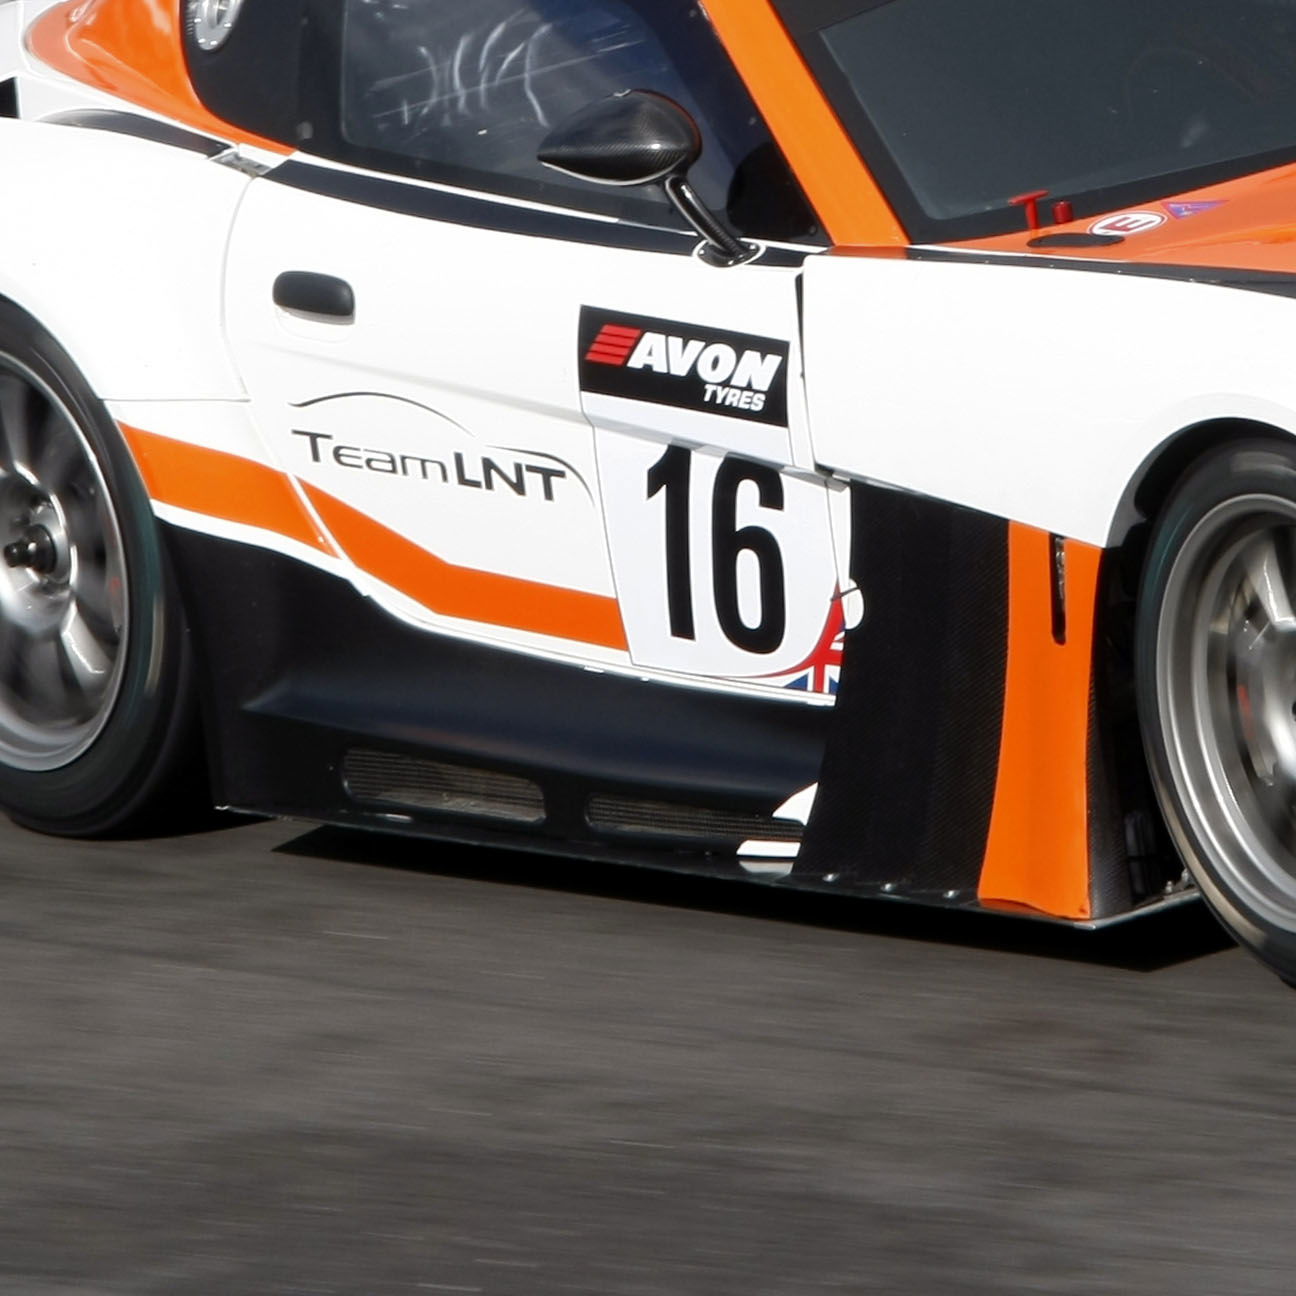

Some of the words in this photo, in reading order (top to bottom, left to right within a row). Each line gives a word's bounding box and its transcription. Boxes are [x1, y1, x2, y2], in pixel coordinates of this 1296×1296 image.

[627, 330, 783, 392] AVON
[703, 383, 766, 412] TYRES
[646, 443, 786, 656] 16
